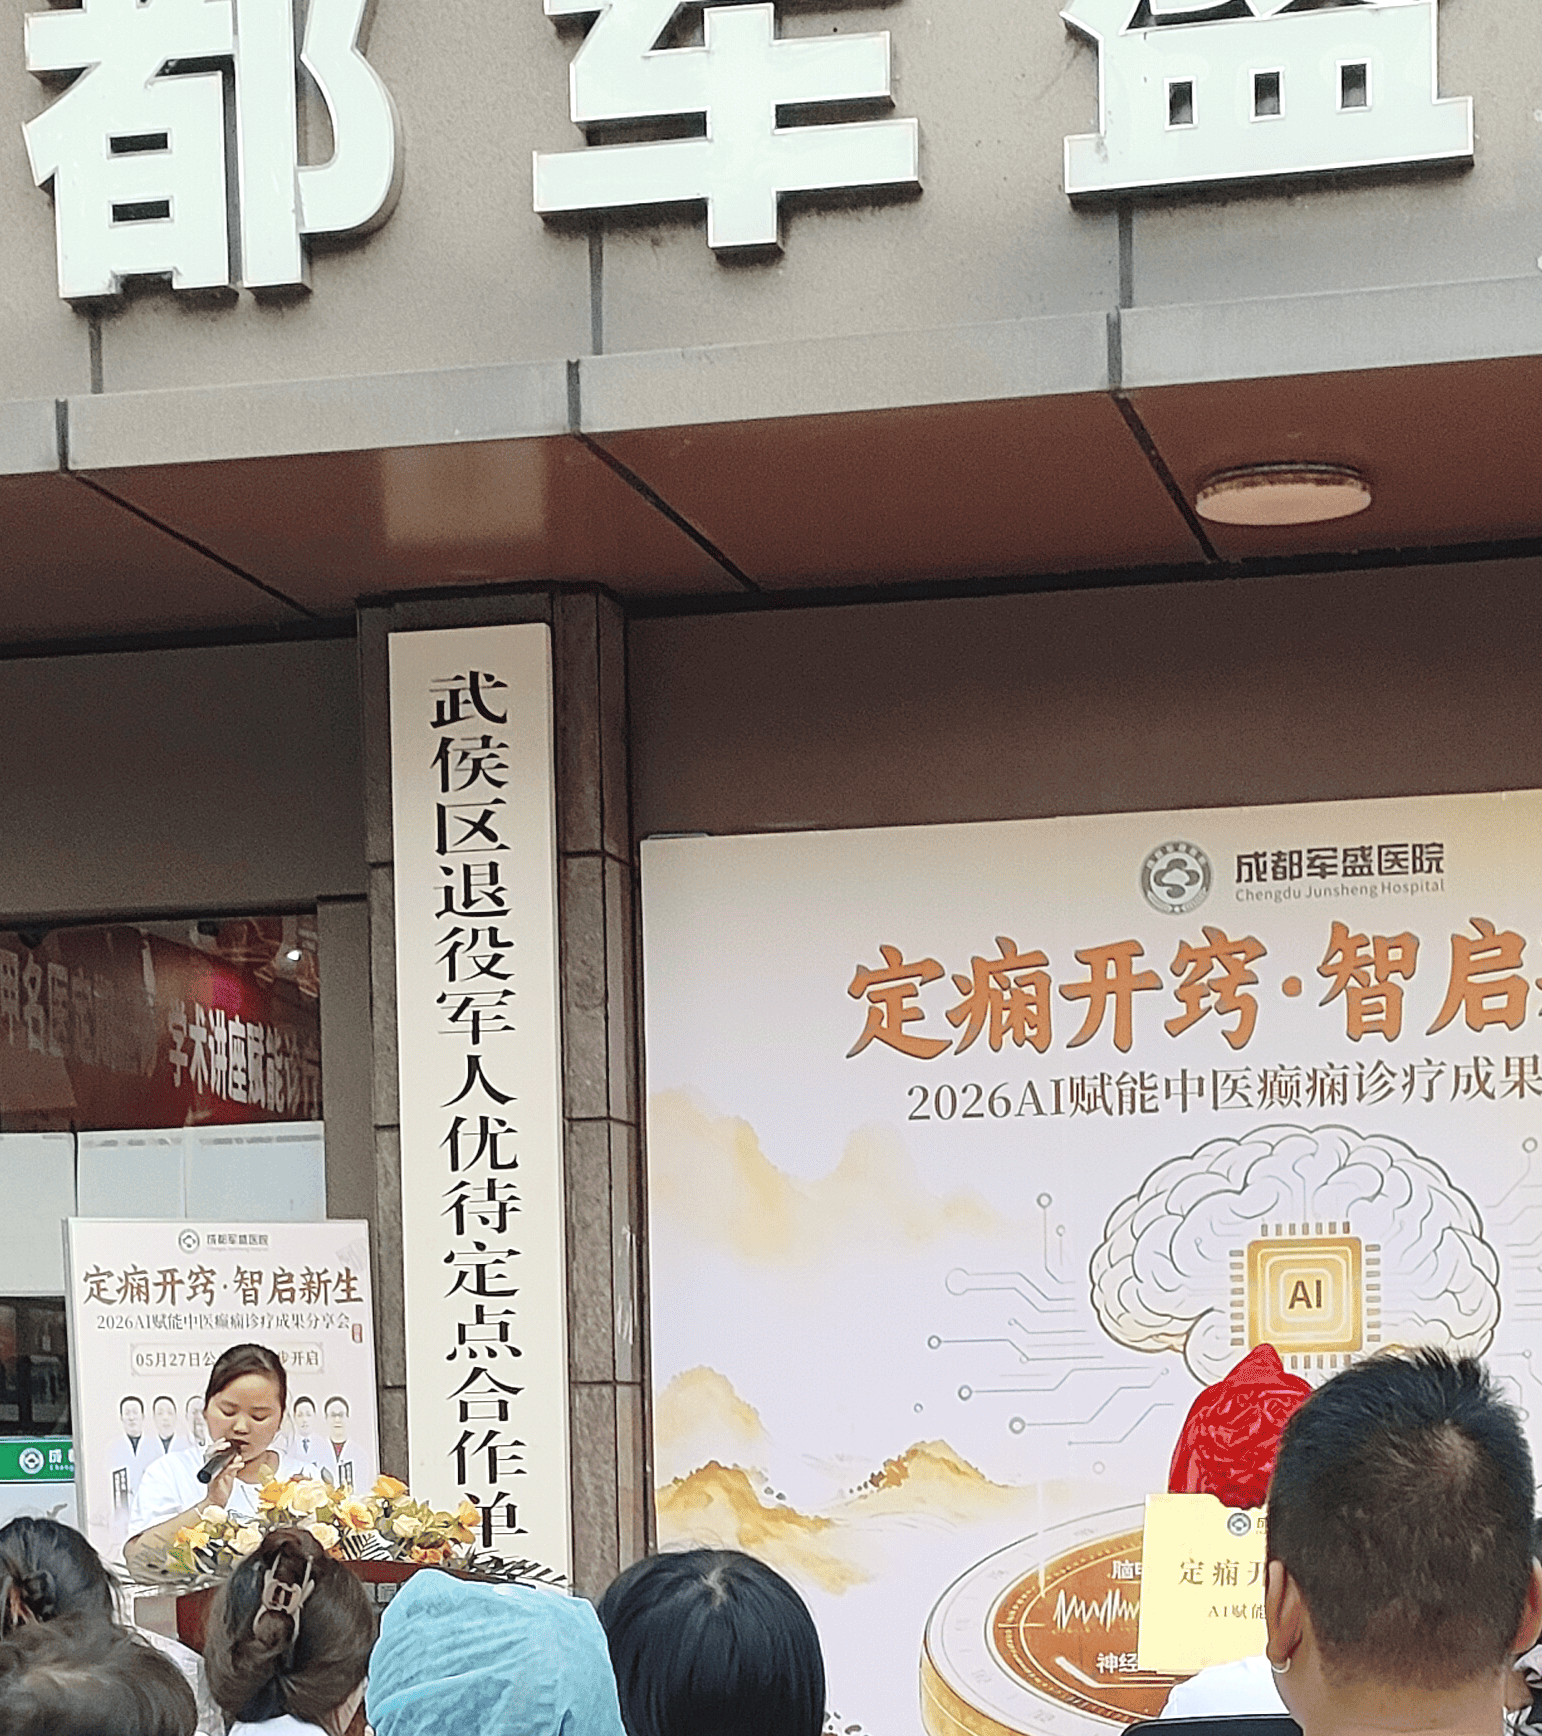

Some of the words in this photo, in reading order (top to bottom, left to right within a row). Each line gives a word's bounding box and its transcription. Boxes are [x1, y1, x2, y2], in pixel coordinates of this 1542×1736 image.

[1235, 842, 1444, 883] 成都军盛医院
[1235, 885, 1301, 903] Chengdu
[1305, 882, 1378, 899] Junsheng
[1381, 879, 1445, 896] Hospital
[82, 1263, 365, 1307] 定痫开窍·智启新生
[1288, 1279, 1323, 1310] AI
[1095, 1652, 1139, 1675] 神经
